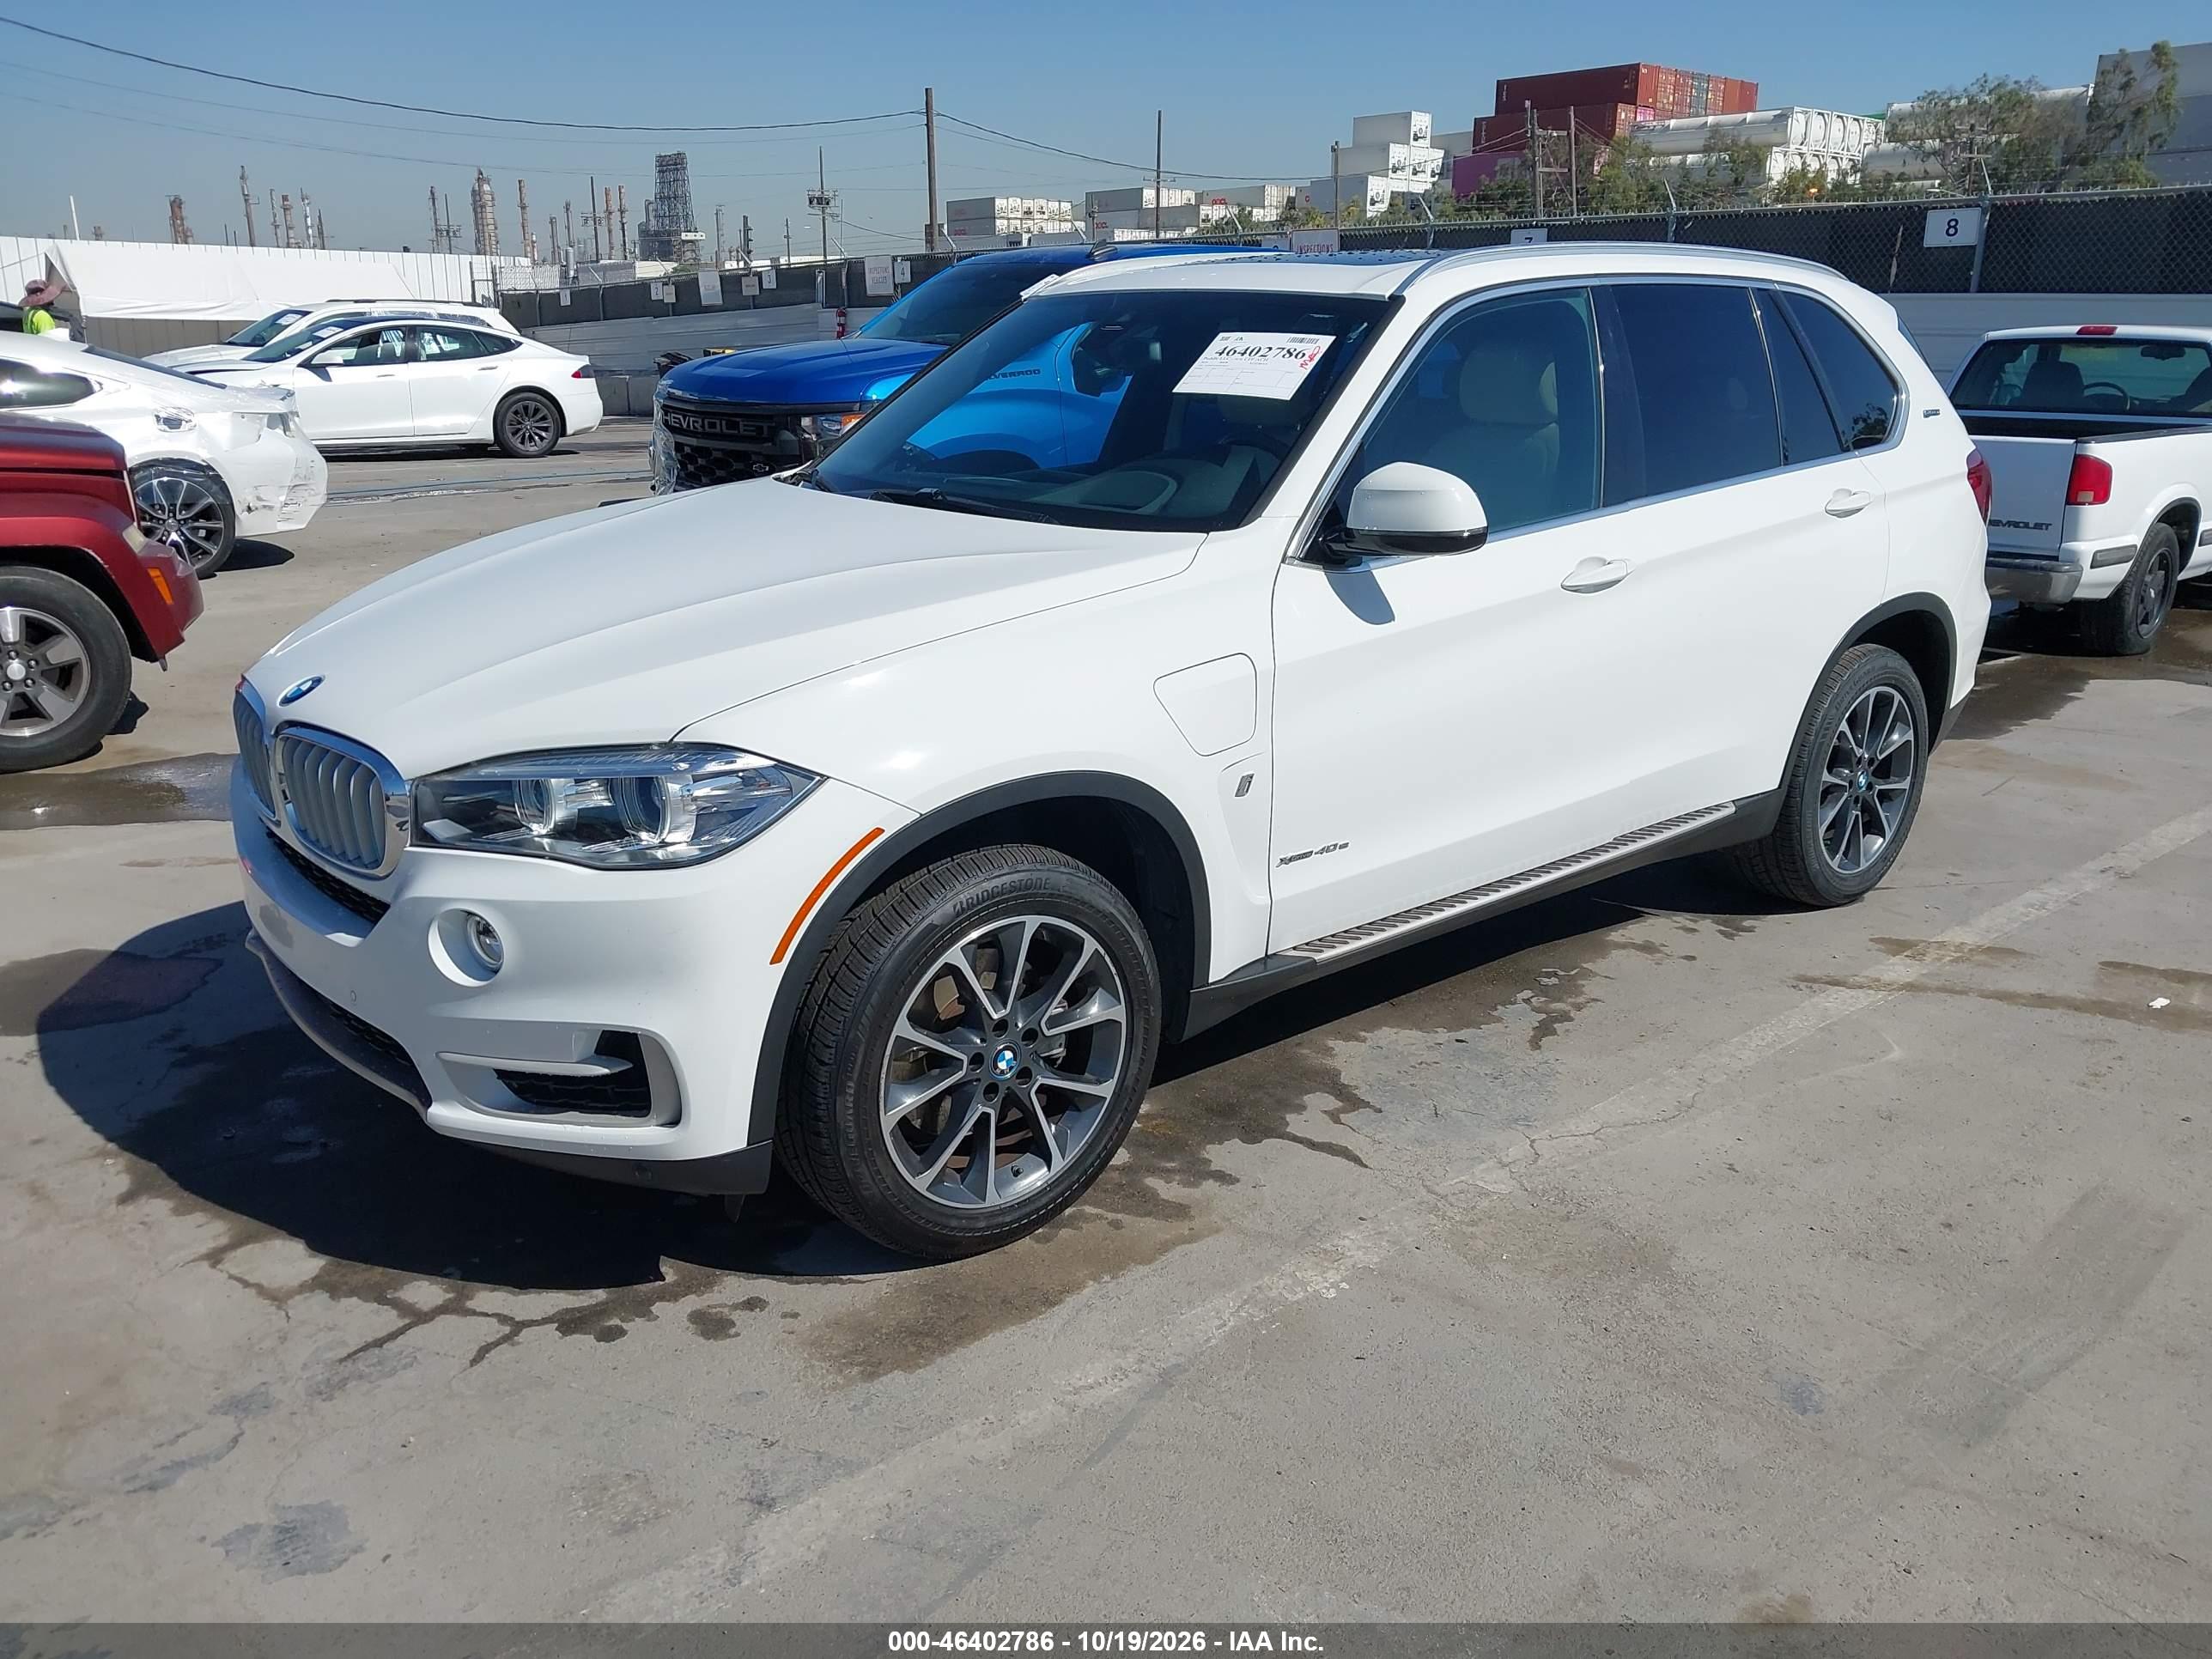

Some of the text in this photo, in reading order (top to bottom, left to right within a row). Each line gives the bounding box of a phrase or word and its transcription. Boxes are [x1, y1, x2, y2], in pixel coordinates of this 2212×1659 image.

[1946, 218, 1959, 237] 8
[900, 267, 906, 278] 4
[1214, 345, 1310, 360] 46402786
[661, 411, 776, 437] HEVROLET
[1989, 519, 2053, 531] EVROLET
